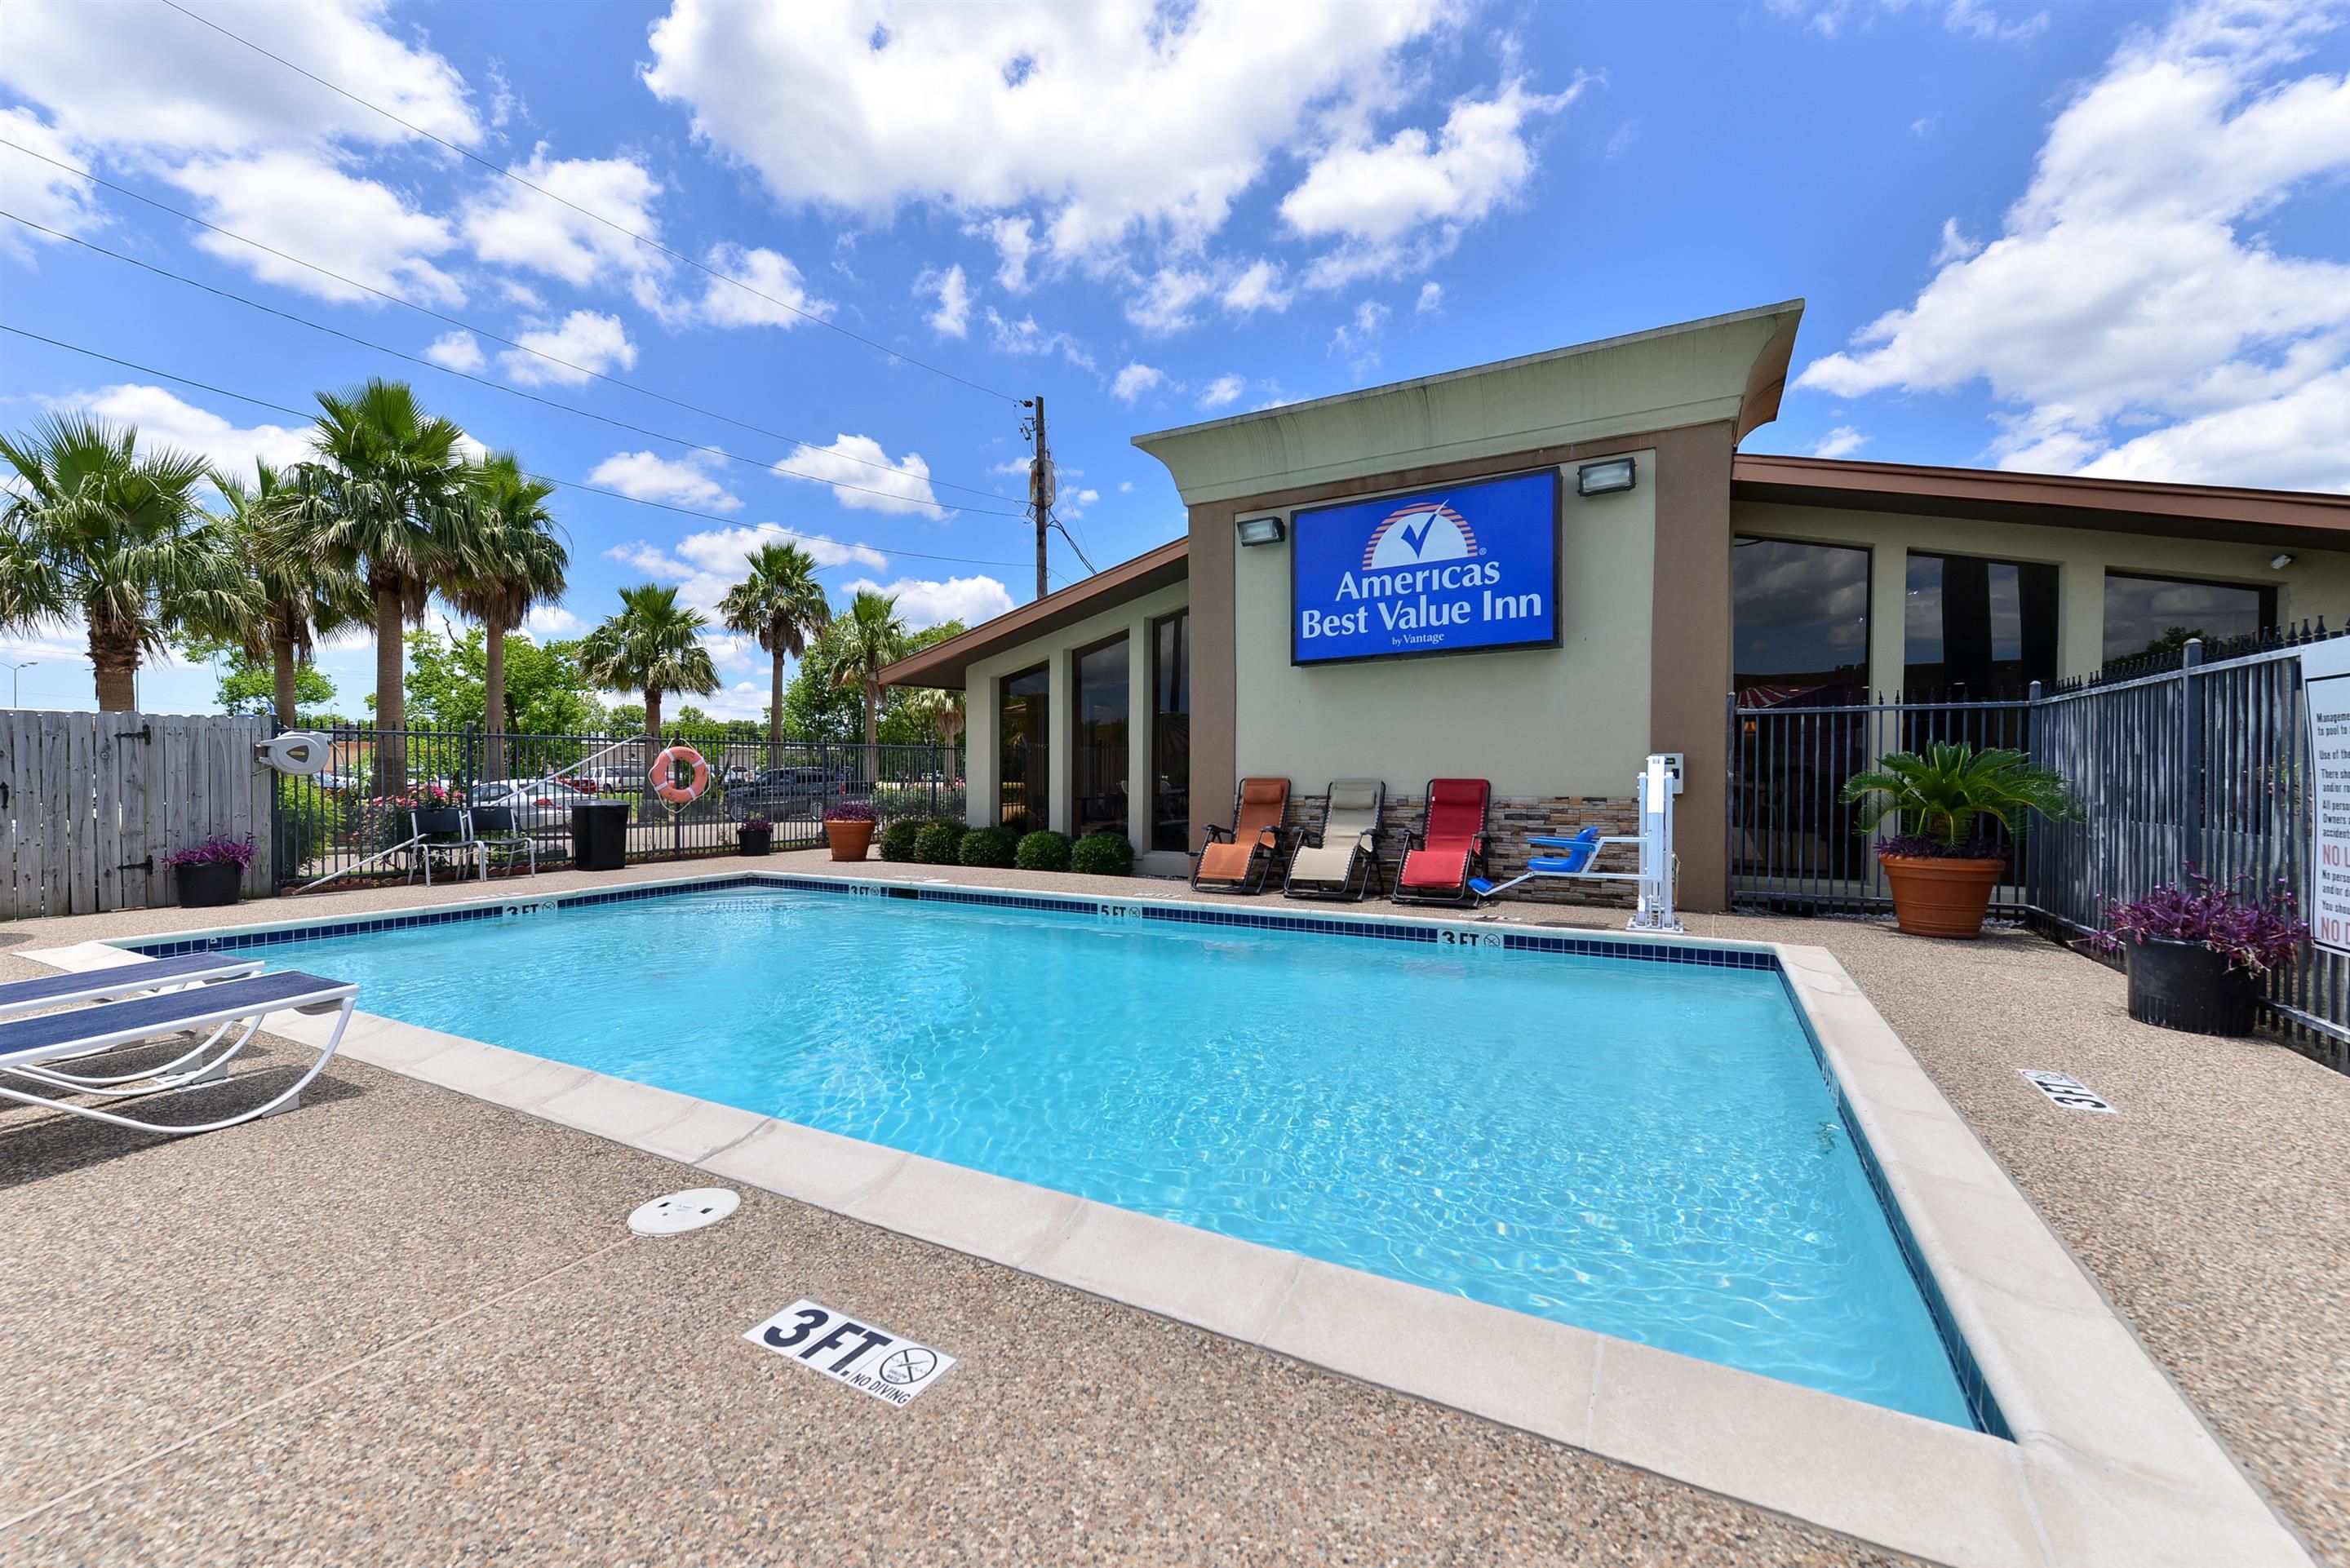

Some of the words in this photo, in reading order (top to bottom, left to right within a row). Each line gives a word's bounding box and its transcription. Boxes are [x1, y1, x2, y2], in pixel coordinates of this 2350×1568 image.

[1335, 560, 1501, 601] Americas
[1302, 605, 1369, 639] Best
[1377, 595, 1471, 631] Value
[1483, 591, 1541, 621] Inn
[1392, 637, 1402, 646] by
[1403, 633, 1444, 644] Vantage
[2317, 726, 2324, 736] to
[2326, 724, 2339, 737] pool
[2341, 724, 2348, 734] to
[2319, 750, 2330, 760] Use
[2332, 749, 2339, 760] of
[2321, 768, 2339, 779] There
[2322, 800, 2330, 810] All
[2323, 813, 2347, 826] Owners
[2323, 844, 2340, 866] NO
[2322, 870, 2330, 880] No
[2322, 885, 2343, 897] and/or
[522, 904, 539, 914] FT
[2321, 899, 2333, 911] You
[2321, 917, 2339, 943] NO
[1442, 931, 1456, 944] 3
[1460, 932, 1479, 946] FT
[764, 1309, 829, 1348] 3
[849, 1373, 871, 1387] NO
[867, 1380, 911, 1404] DIVING
